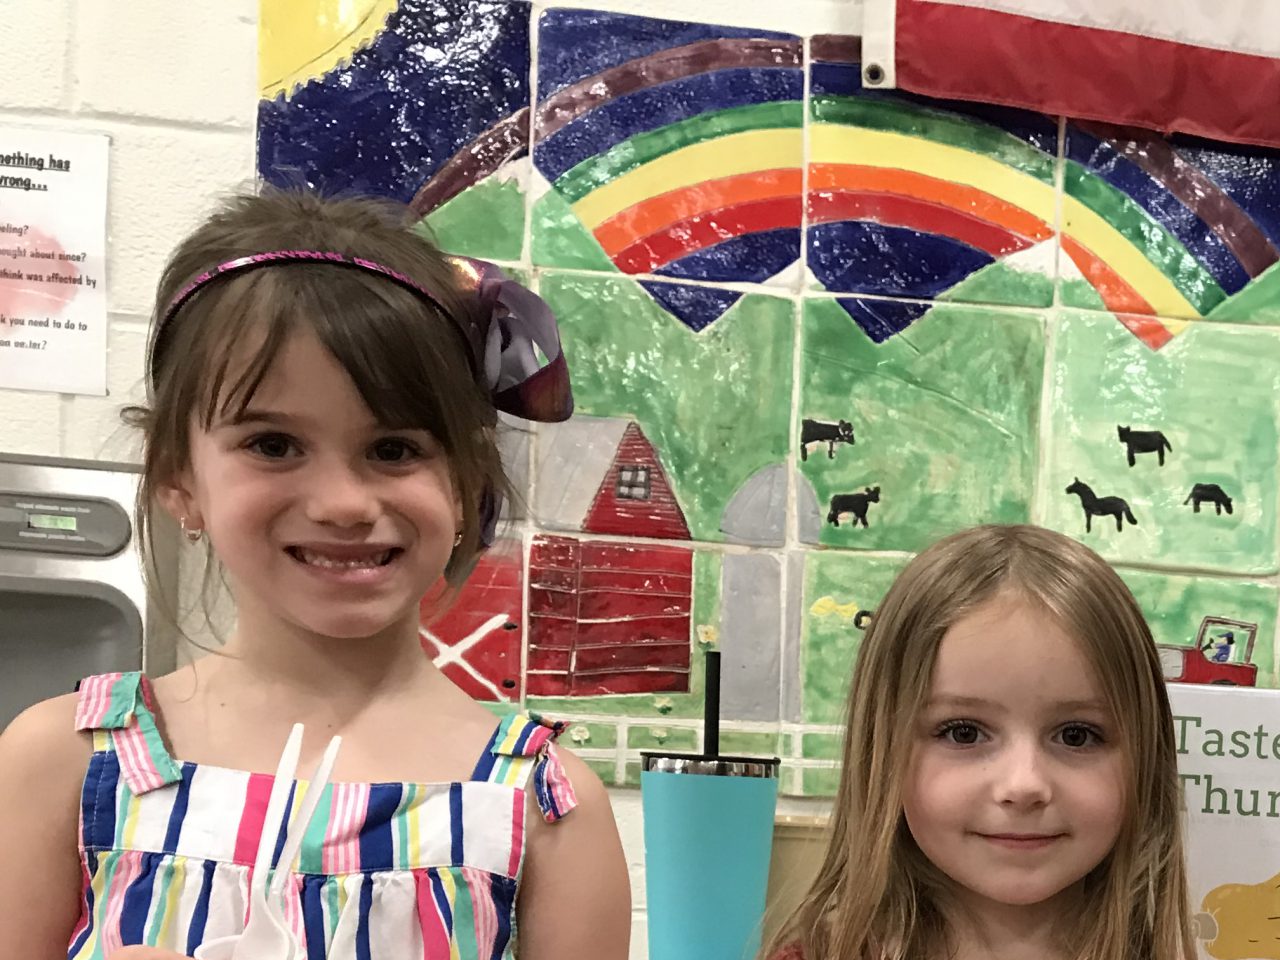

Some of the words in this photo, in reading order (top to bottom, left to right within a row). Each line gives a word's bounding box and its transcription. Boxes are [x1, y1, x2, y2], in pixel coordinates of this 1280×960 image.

[49, 154, 71, 170] has
[86, 275, 97, 289] by
[28, 317, 49, 328] need
[79, 322, 88, 331] to
